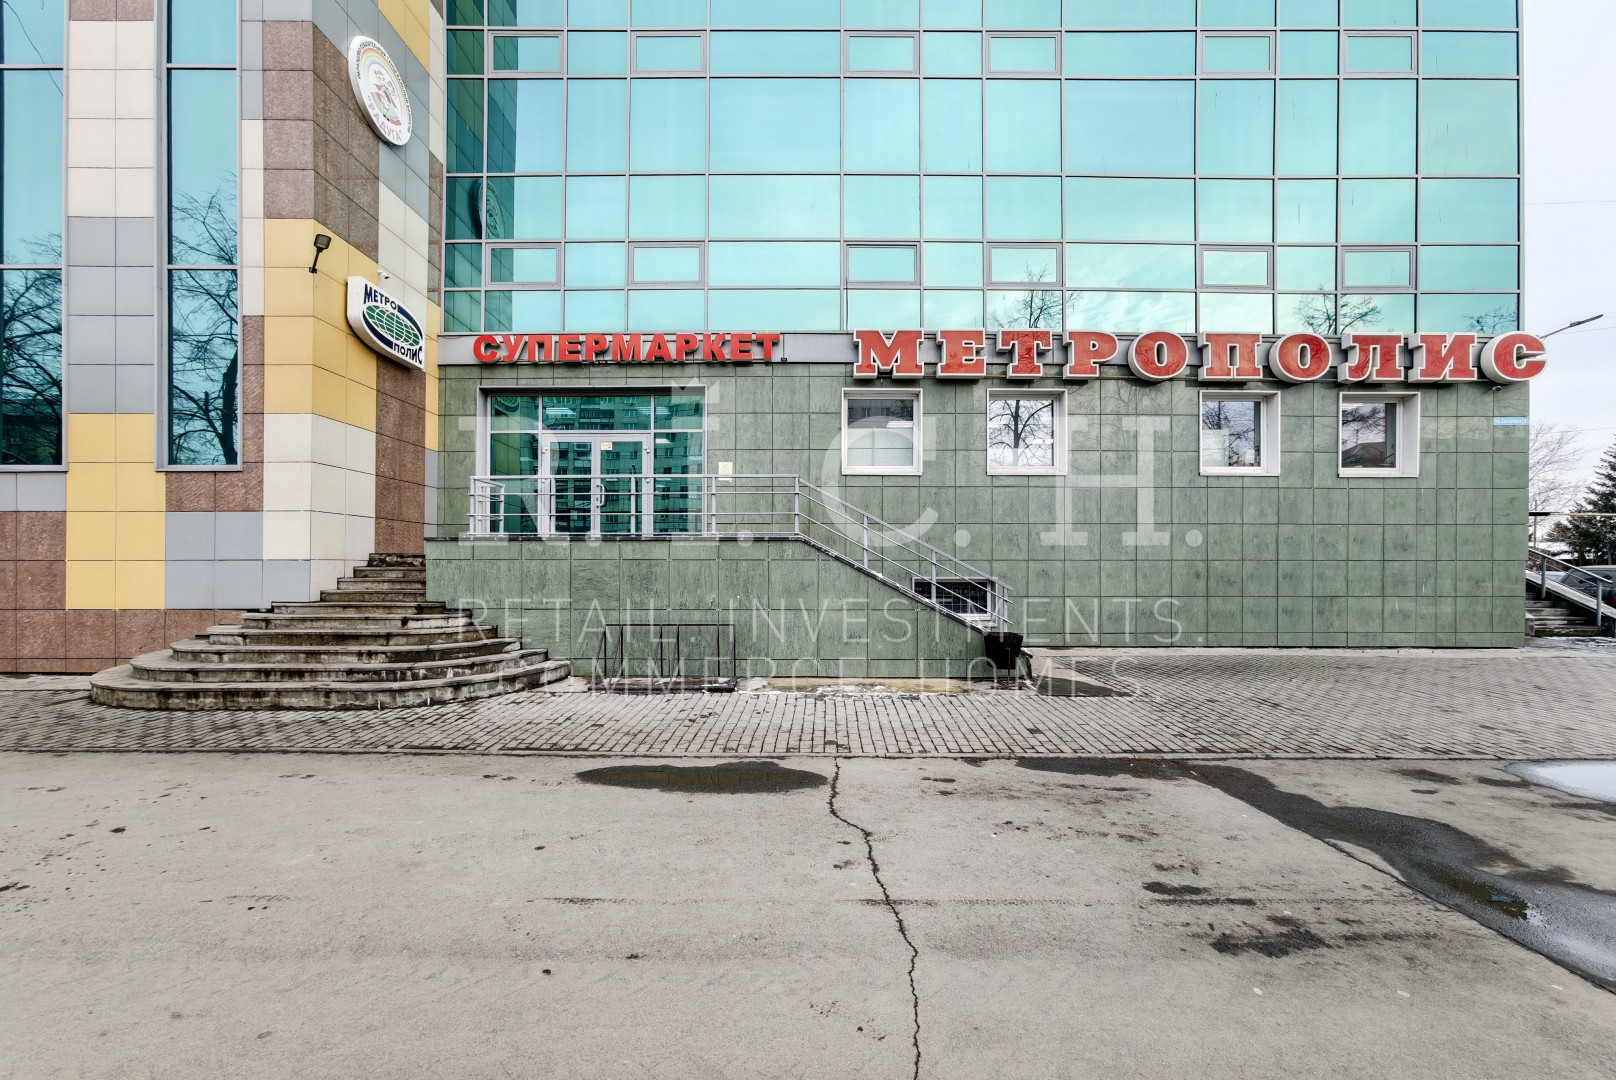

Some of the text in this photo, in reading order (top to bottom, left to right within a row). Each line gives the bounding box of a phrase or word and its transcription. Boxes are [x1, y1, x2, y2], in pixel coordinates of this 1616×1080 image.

[363, 283, 397, 310] МЕТРО
[394, 342, 423, 365] ПОЛИС
[472, 332, 781, 364] СУПЕРМАРКЕТ
[852, 328, 1548, 382] МЕТРОПОЛИС
